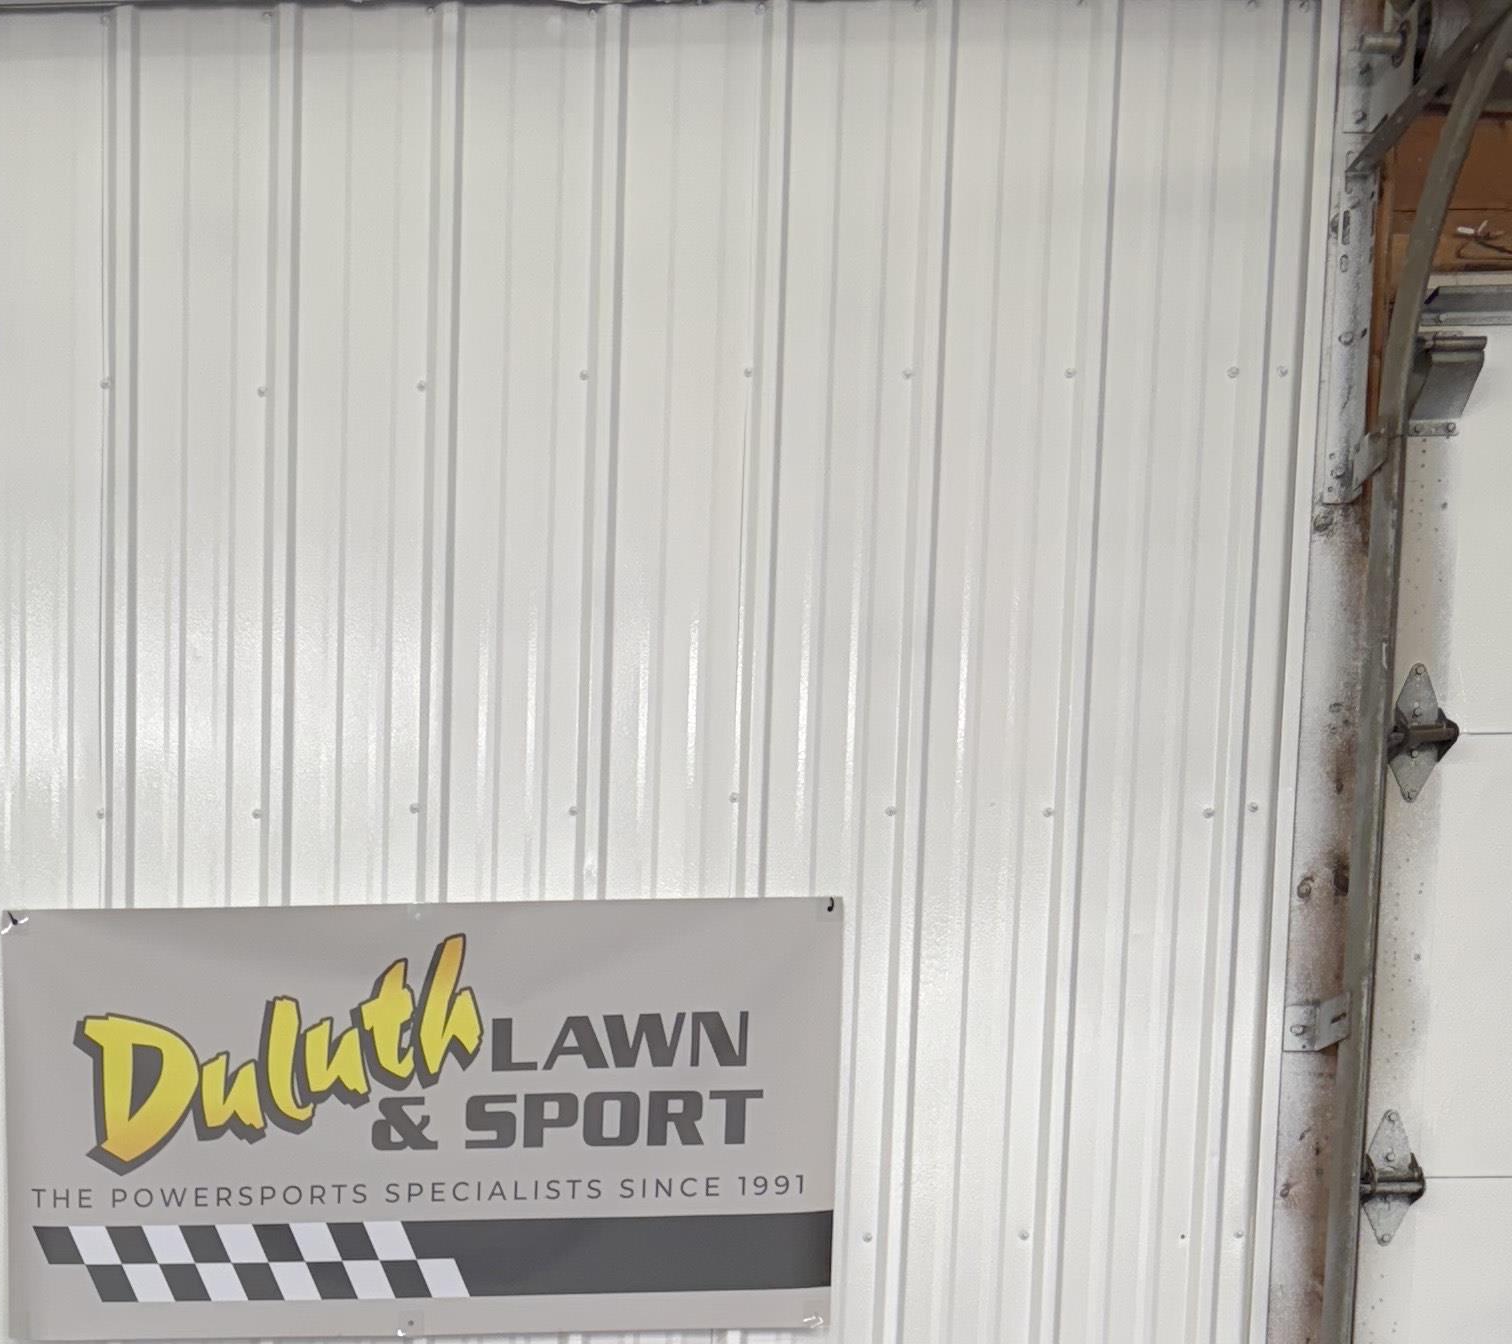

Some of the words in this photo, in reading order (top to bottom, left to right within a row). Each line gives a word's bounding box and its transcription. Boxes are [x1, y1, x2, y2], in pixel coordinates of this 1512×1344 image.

[74, 933, 484, 1175] Duluth
[492, 1011, 750, 1072] LAWN
[371, 1096, 438, 1151] &
[464, 1089, 765, 1150] SPORT
[31, 1188, 93, 1209] THE
[111, 1184, 368, 1208] POWERSPORTS
[385, 1178, 603, 1203] SPECIALISTS
[619, 1176, 721, 1199] SINCE
[738, 1174, 807, 1196] 1991
